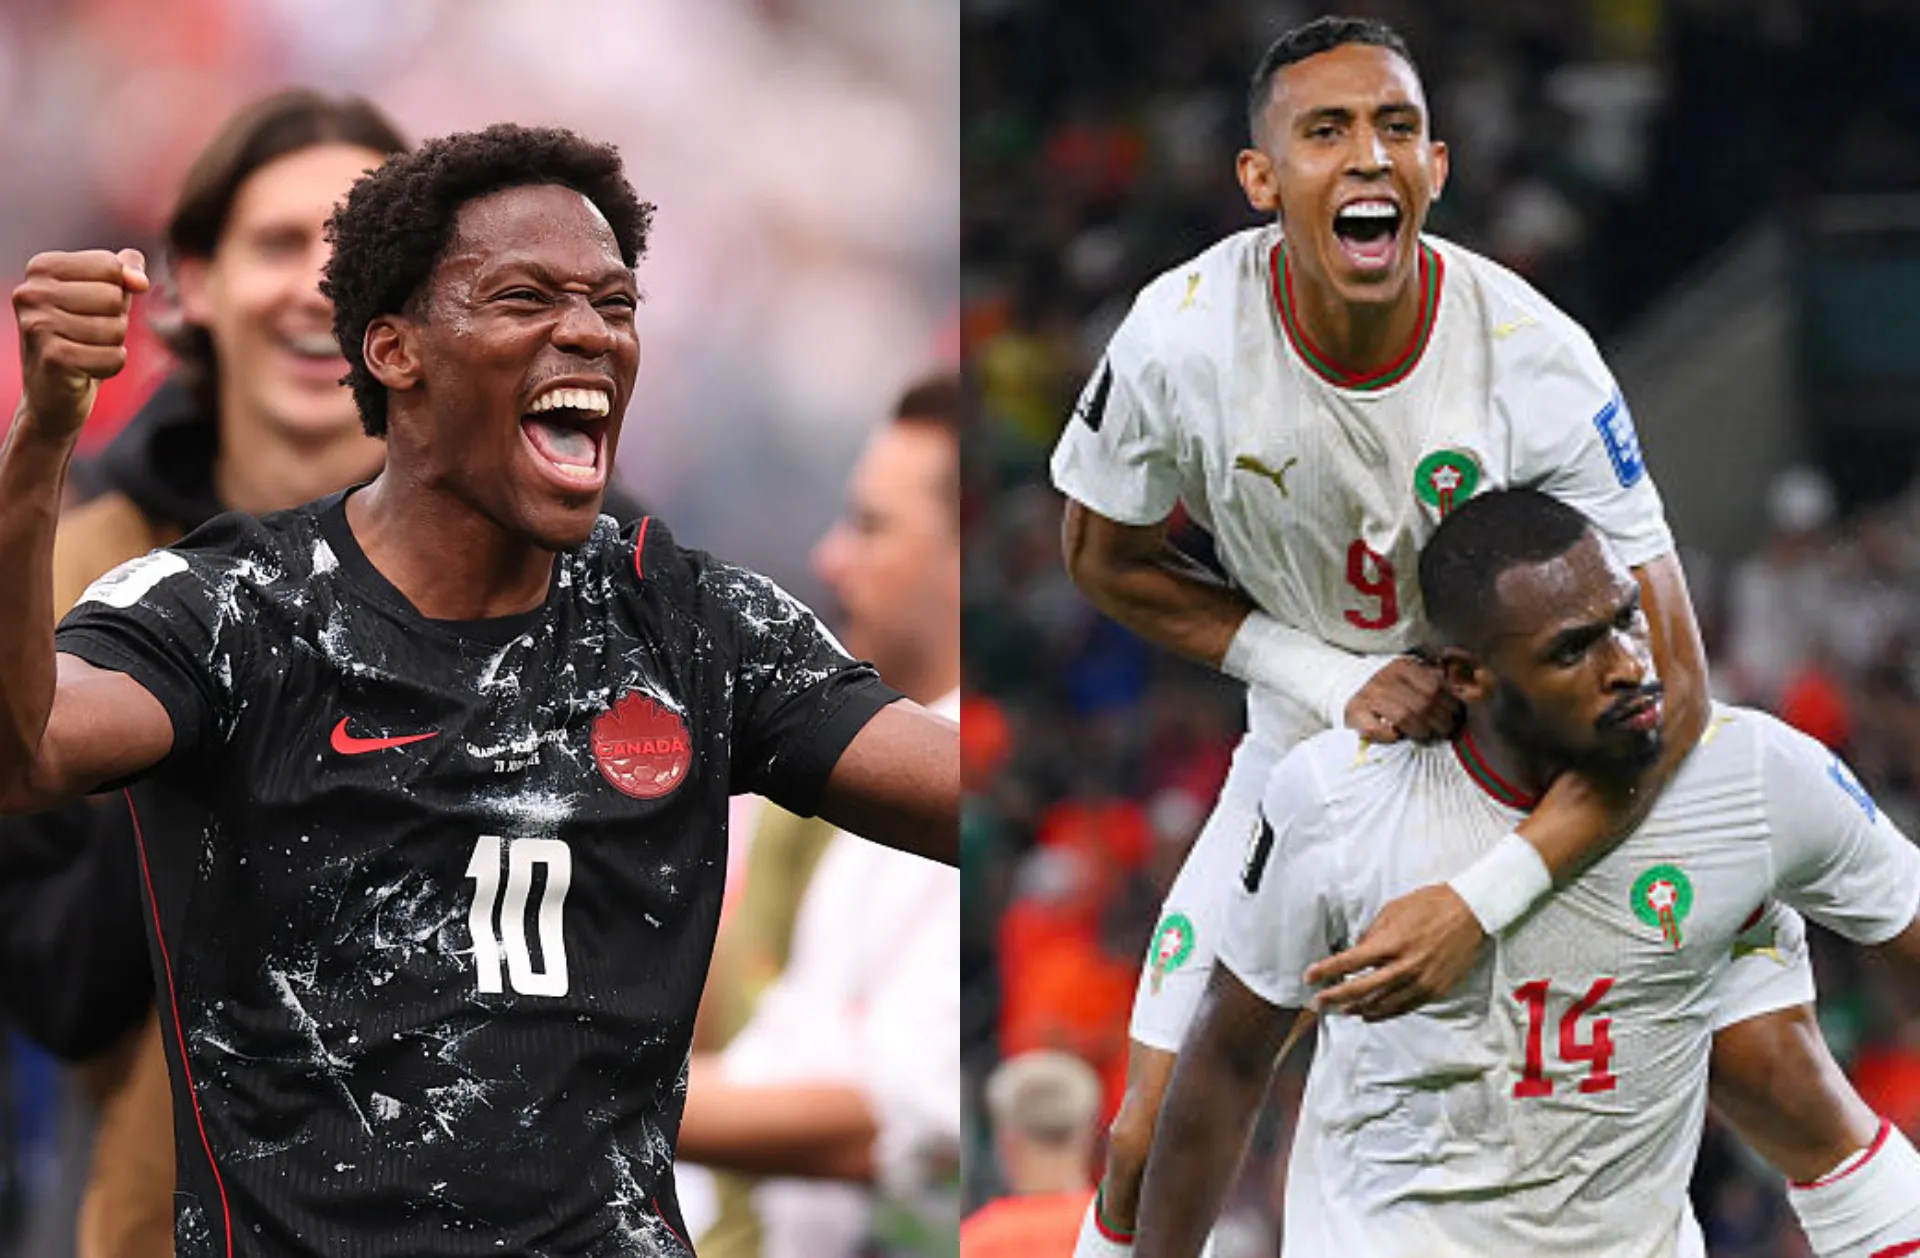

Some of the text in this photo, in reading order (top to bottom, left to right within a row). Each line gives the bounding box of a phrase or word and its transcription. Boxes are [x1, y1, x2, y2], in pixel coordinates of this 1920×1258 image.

[1345, 538, 1399, 629] 9
[599, 738, 686, 757] CANADA
[465, 835, 572, 997] 10
[1512, 977, 1616, 1098] 14
